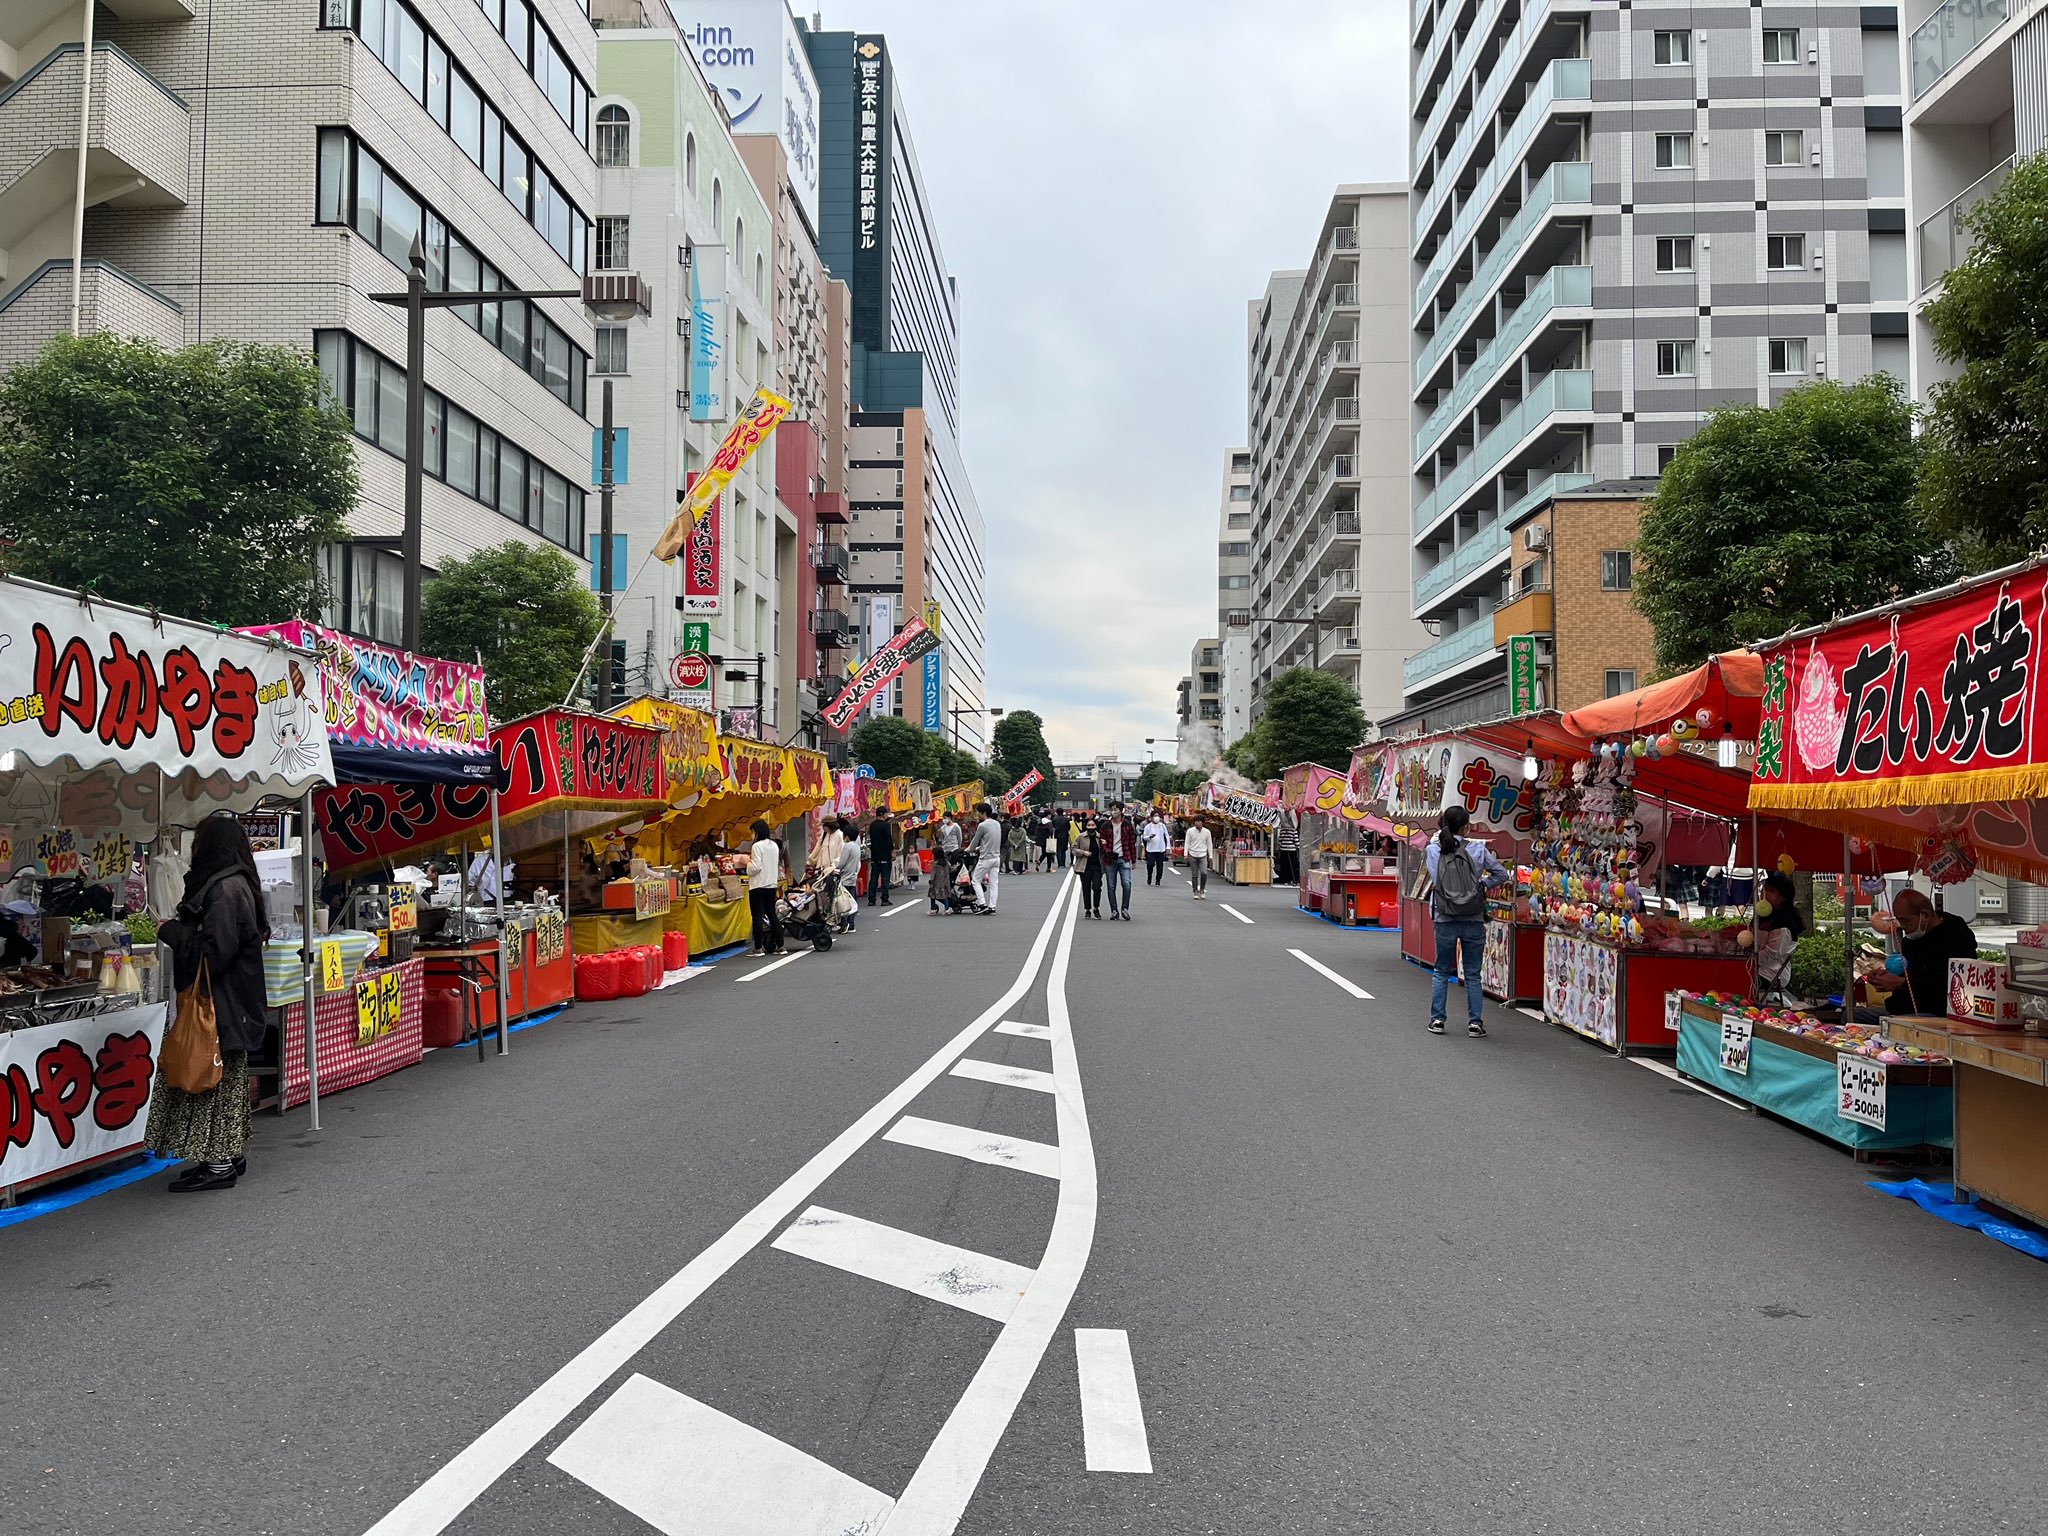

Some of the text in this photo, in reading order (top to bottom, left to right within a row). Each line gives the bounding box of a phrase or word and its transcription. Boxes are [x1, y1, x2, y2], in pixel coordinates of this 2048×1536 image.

[330, 1, 342, 26] 外科
[860, 60, 878, 249] 住友不動産大井町駅前ビル
[693, 305, 721, 357] yuki
[696, 360, 718, 370] soap
[693, 504, 714, 588] 焼肉酒家
[688, 626, 702, 657] 漢方
[33, 622, 259, 757] いかやき
[351, 644, 428, 708] ドリンク
[679, 664, 705, 678] 消火栓
[1514, 640, 1531, 715] (有)サクラ屋不
[1834, 594, 2033, 778] たい焼
[258, 678, 289, 705] 味自慢
[470, 680, 485, 740] お茶
[926, 655, 937, 727] シティ・ハウジング
[421, 706, 472, 744] ショップ
[1755, 653, 1788, 780] 特製
[582, 723, 646, 794] やきとり
[735, 755, 784, 794] やきそば
[324, 726, 546, 855] やきとり
[37, 828, 76, 860] 丸焼
[92, 832, 130, 862] カット
[47, 852, 78, 877] 900
[97, 853, 130, 880] します
[327, 943, 339, 981] ラムネ
[1966, 964, 1997, 992] たい焼
[358, 982, 377, 1041] サワー
[1724, 1023, 1749, 1043] ヨーヨー
[1728, 1047, 1749, 1066] 200円
[1841, 1060, 1881, 1097] ビニールヨーヨー
[1854, 1099, 1879, 1119] 500円
